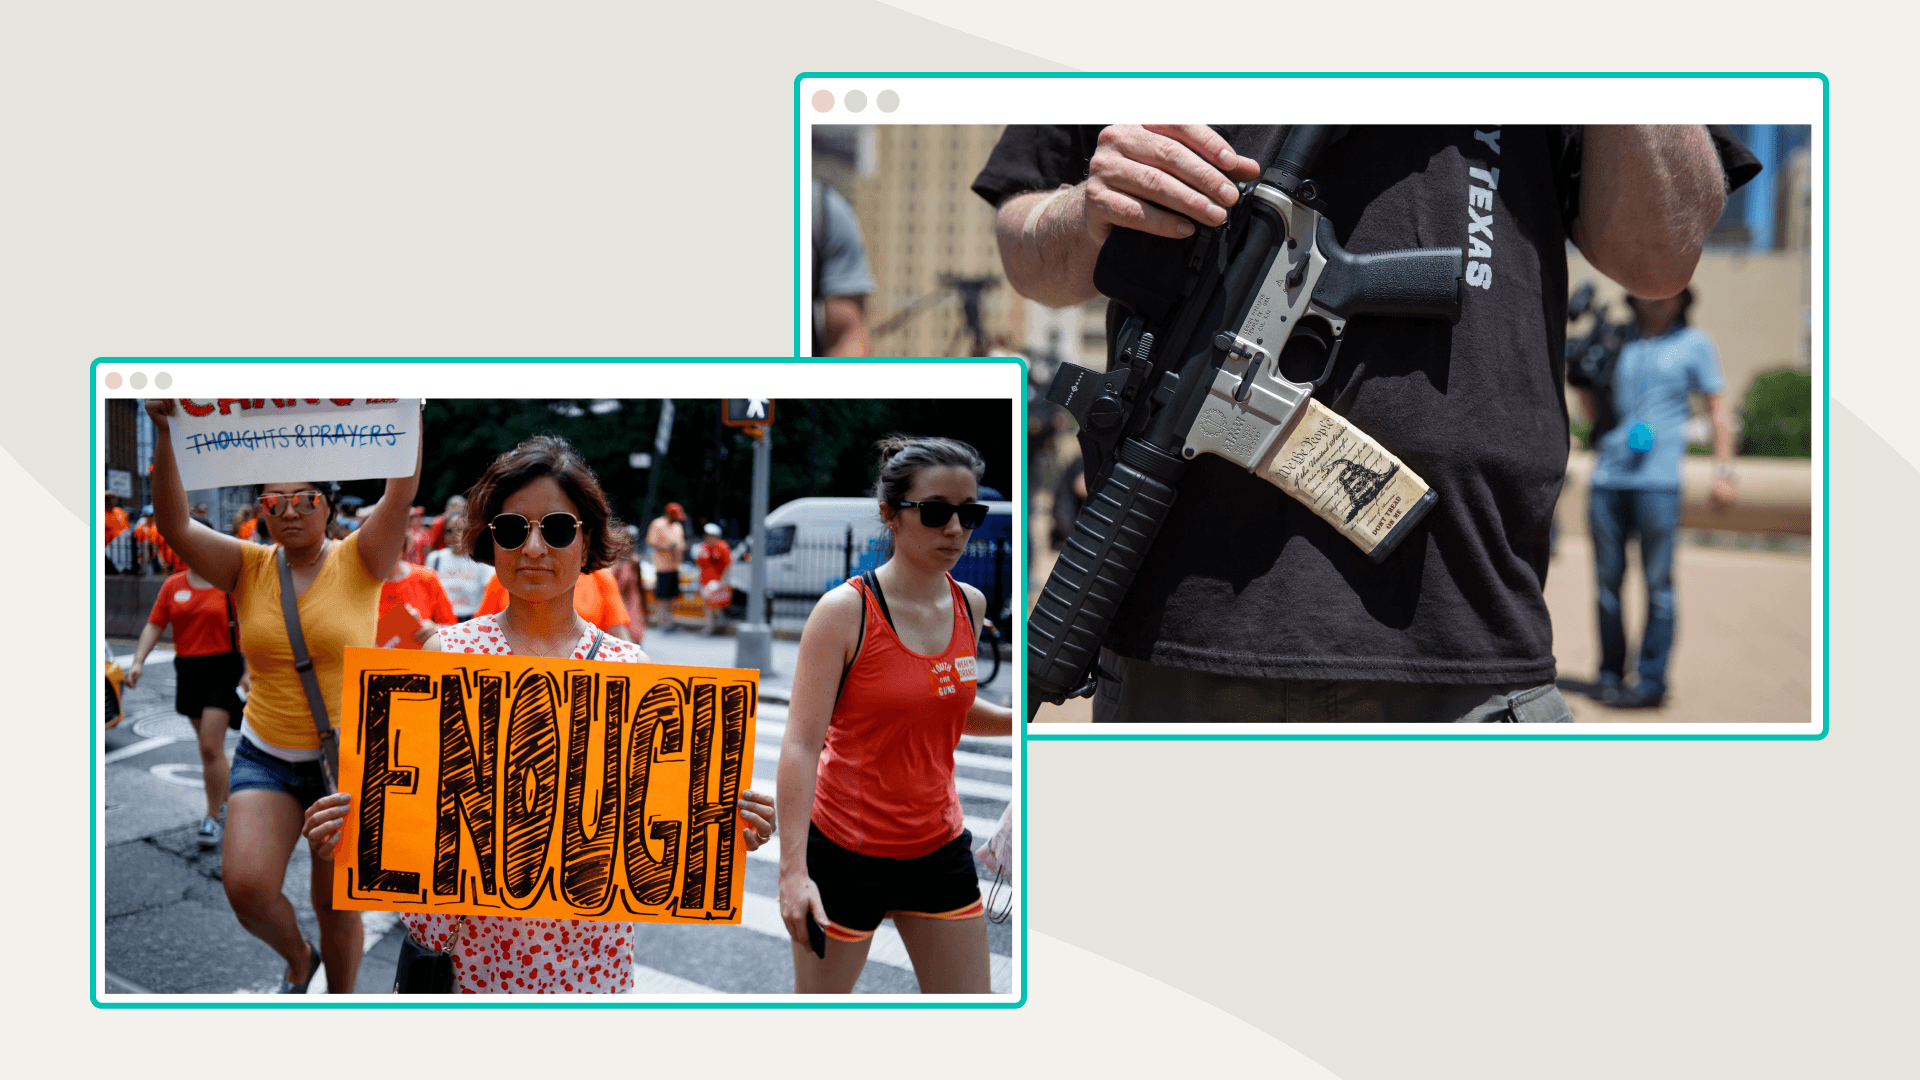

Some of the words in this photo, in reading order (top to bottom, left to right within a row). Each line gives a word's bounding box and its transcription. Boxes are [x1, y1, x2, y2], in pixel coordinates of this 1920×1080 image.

[1465, 166, 1500, 290] TEXAS
[186, 427, 290, 454] THOUGHTS
[309, 423, 398, 448] PRAYERS
[1276, 461, 1296, 480] We
[1289, 447, 1309, 465] the
[1300, 416, 1336, 452] People
[1384, 496, 1402, 516] TREAD
[1391, 509, 1403, 521] ME
[931, 662, 952, 674] YOUTH
[938, 684, 956, 696] GUNS
[353, 668, 752, 914] ENOUGH
